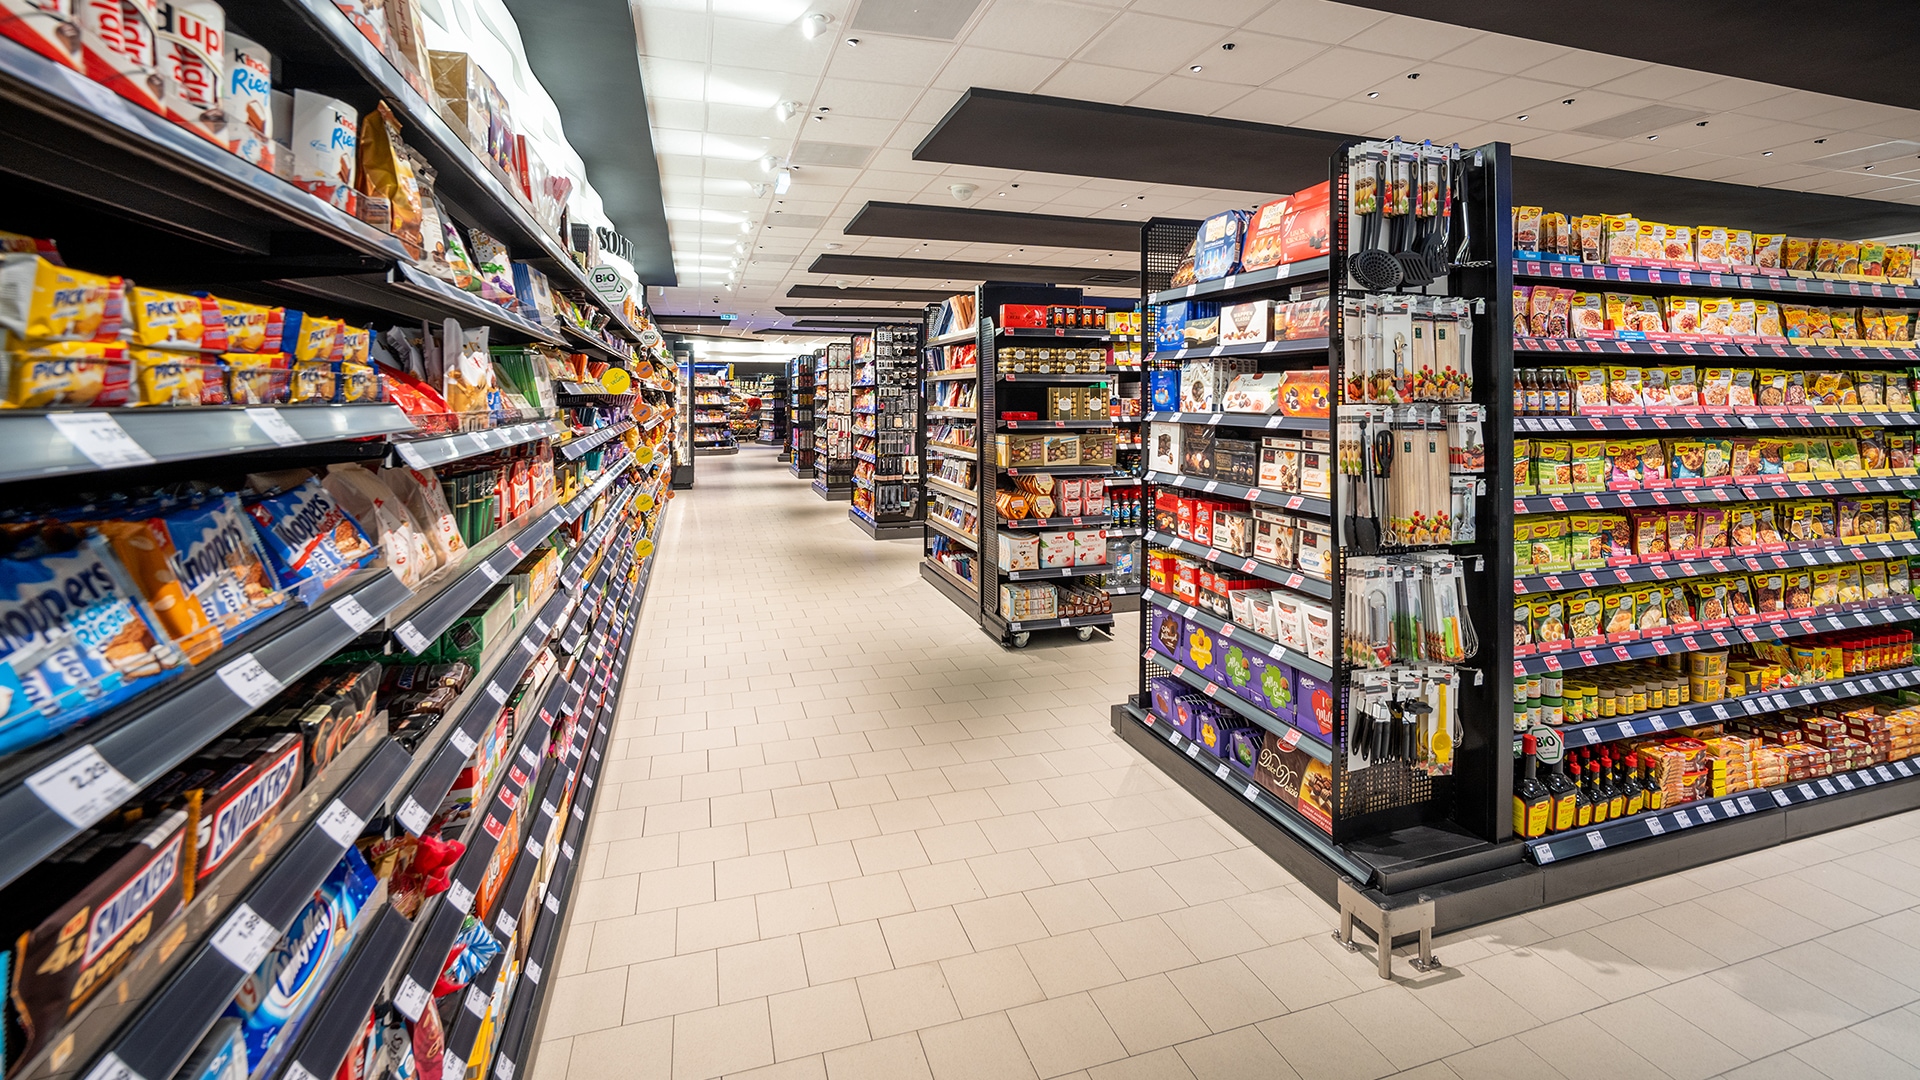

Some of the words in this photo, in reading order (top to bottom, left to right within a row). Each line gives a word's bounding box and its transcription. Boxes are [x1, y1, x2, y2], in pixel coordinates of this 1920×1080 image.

[595, 273, 615, 283] BiO
[146, 301, 175, 316] PiCK
[176, 299, 199, 314] UP!
[610, 375, 625, 386] VEGAN
[272, 493, 330, 553] Knoppers
[170, 518, 243, 594] Knoppers
[1251, 656, 1264, 666] Milka
[1264, 676, 1279, 689] Alles
[1300, 677, 1315, 689] Milka
[1272, 686, 1286, 697] Gute
[216, 753, 297, 860] SNICKERS
